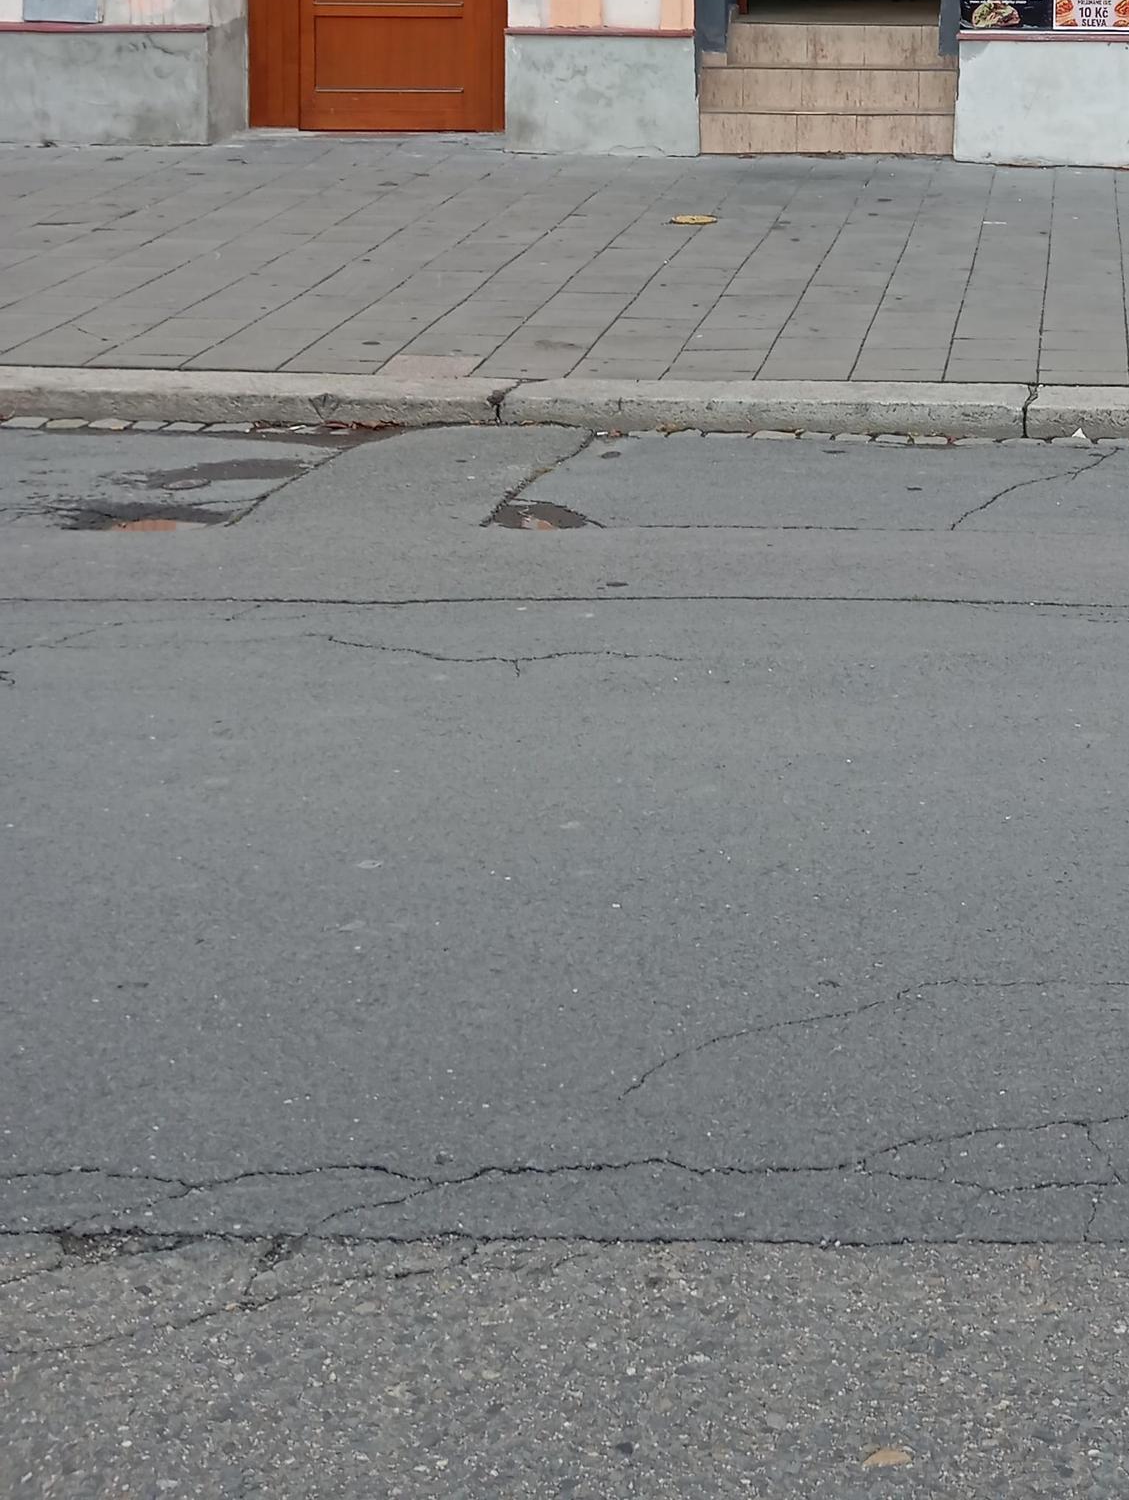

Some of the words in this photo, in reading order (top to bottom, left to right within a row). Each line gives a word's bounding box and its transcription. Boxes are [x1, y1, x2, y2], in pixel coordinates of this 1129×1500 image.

[1079, 6, 1092, 18] 10
[1095, 6, 1109, 18] Kč
[1081, 18, 1108, 27] SLEVA
